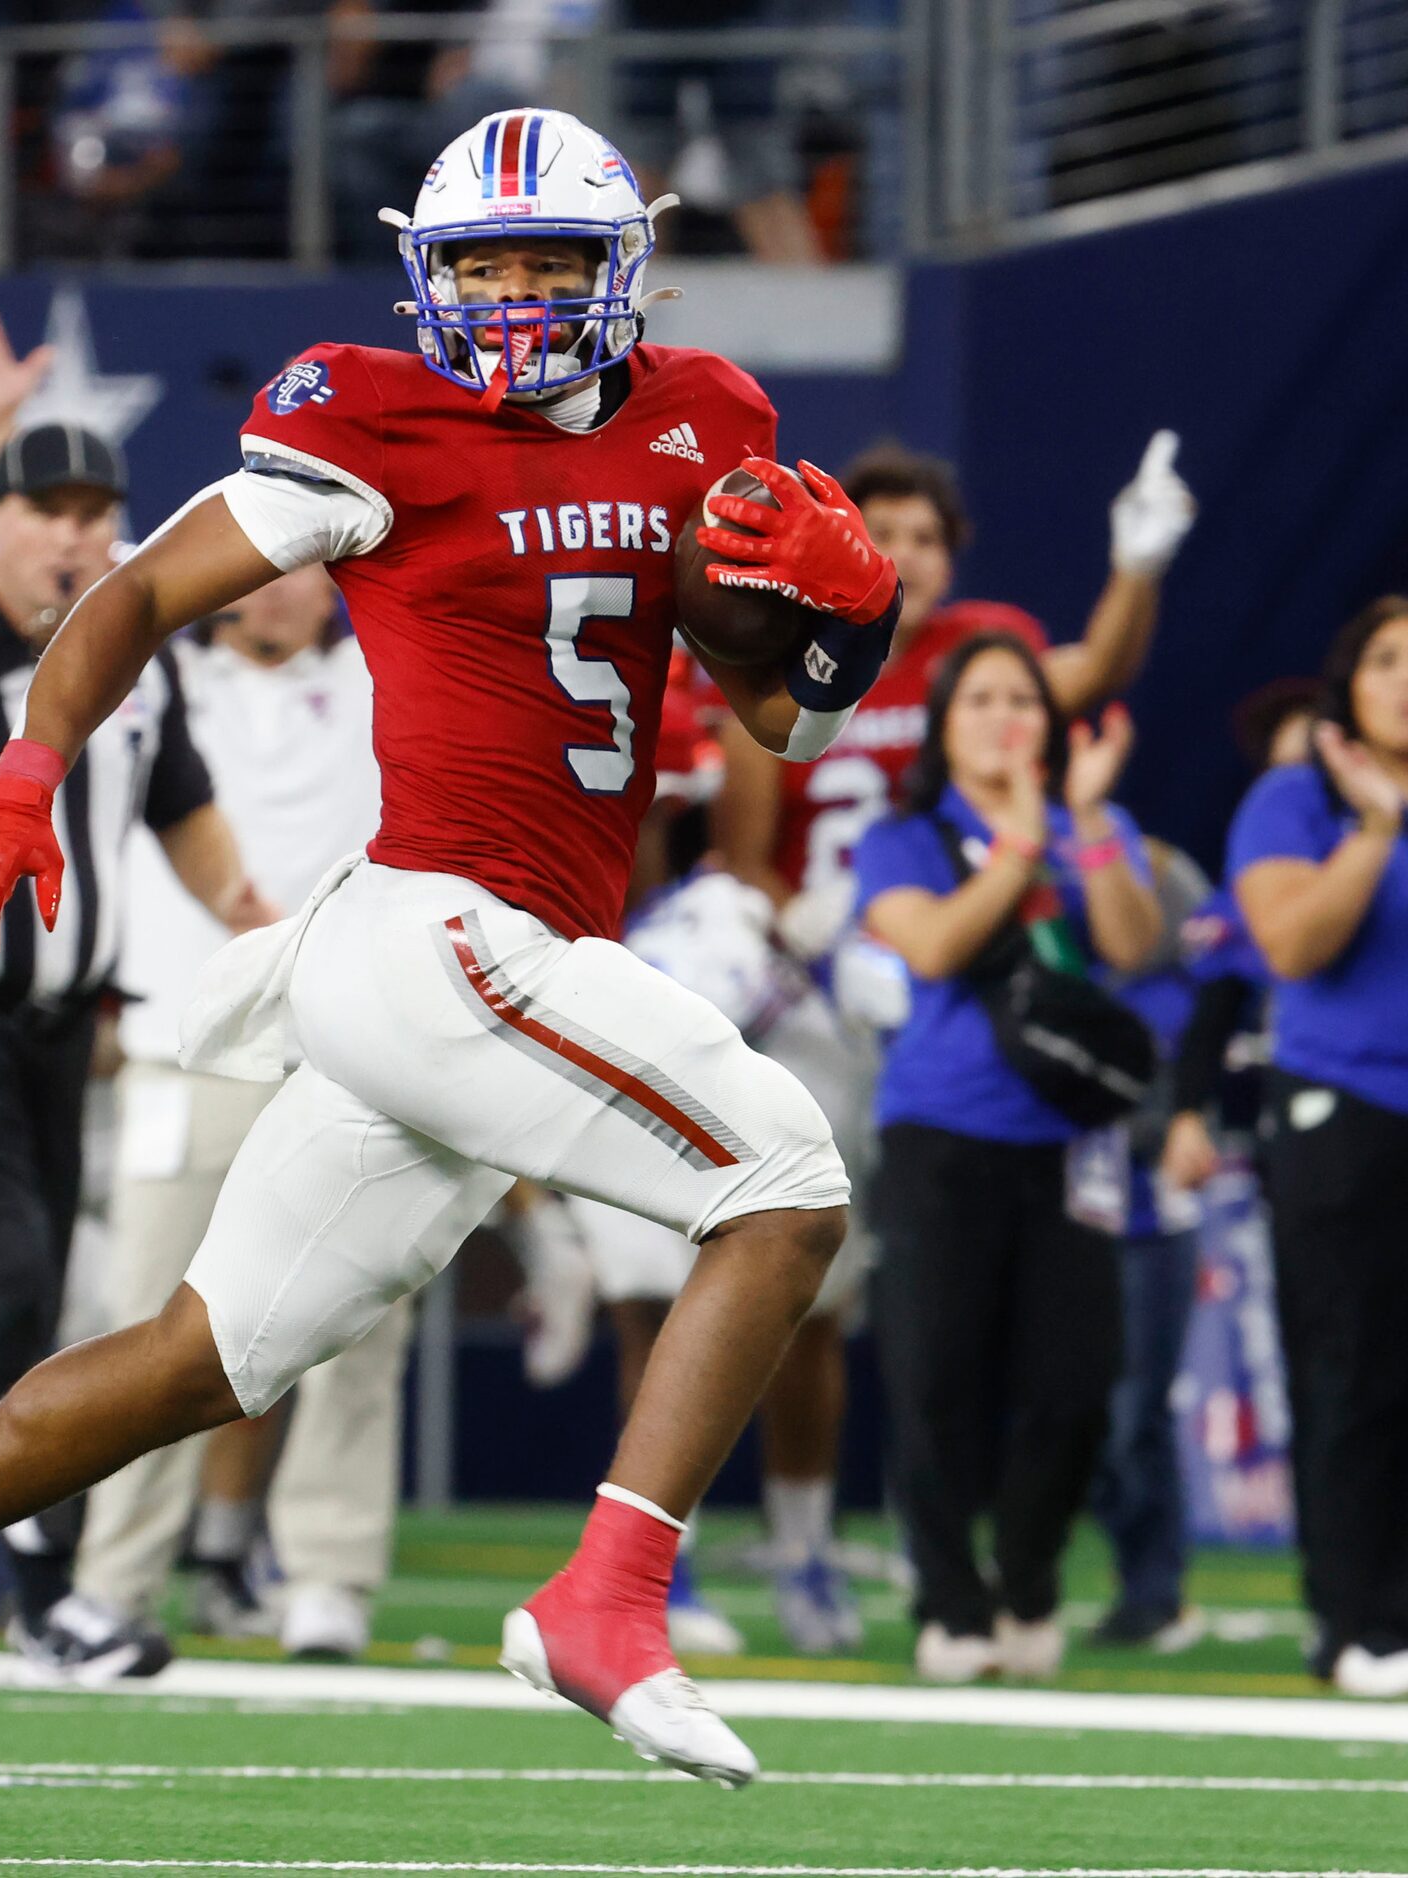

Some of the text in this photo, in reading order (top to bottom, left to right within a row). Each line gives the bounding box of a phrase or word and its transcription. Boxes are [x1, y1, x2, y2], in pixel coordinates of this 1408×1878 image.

[649, 440, 705, 465] adidas
[496, 501, 672, 556] TIGERS
[544, 572, 636, 796] 5
